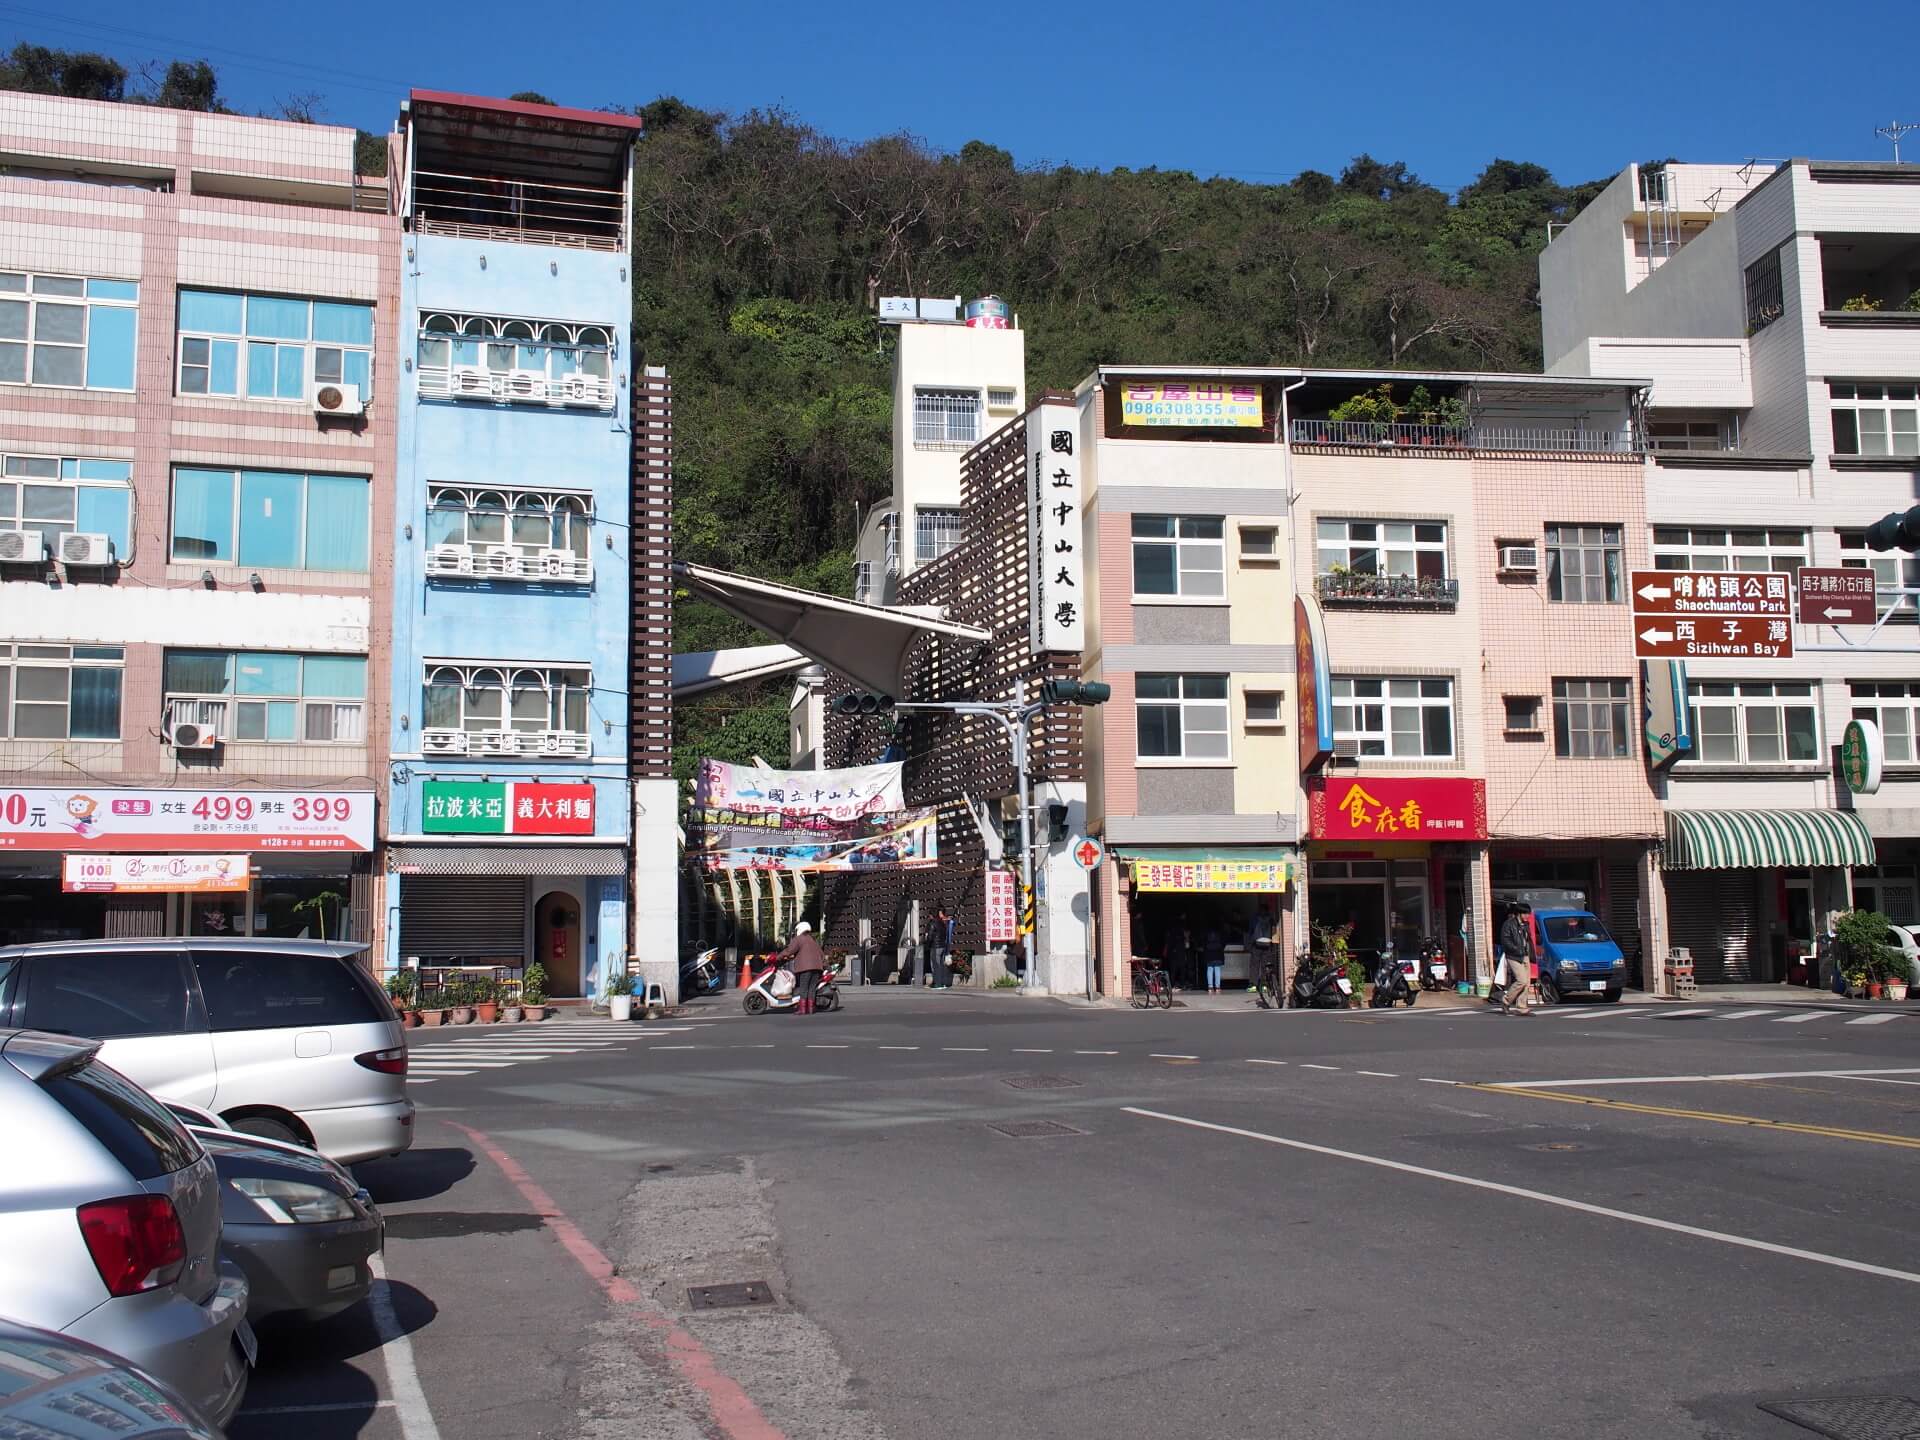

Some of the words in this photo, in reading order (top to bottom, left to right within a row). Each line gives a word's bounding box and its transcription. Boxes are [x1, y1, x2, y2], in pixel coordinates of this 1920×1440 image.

[886, 302, 911, 312] 三久
[1127, 384, 1256, 402] 吉屋出售
[1125, 402, 1223, 415] 0986308355
[1050, 430, 1076, 627] 國立中山大學
[1673, 575, 1786, 599] 哨船頭公園
[1802, 575, 1873, 593] 西子灣蔣介石行館
[1675, 599, 1755, 612] Shaochuantou
[1760, 600, 1786, 612] Park
[1675, 620, 1788, 642] 西子灣
[1686, 642, 1748, 654] Sizihwan
[1754, 642, 1780, 656] Bay
[160, 801, 187, 814] 女生
[192, 796, 254, 820] 499
[260, 801, 286, 814] 男生
[292, 797, 351, 821] 399
[427, 796, 503, 819] 拉波米亞
[516, 798, 592, 819] 義大利麵
[30, 808, 47, 827] 元
